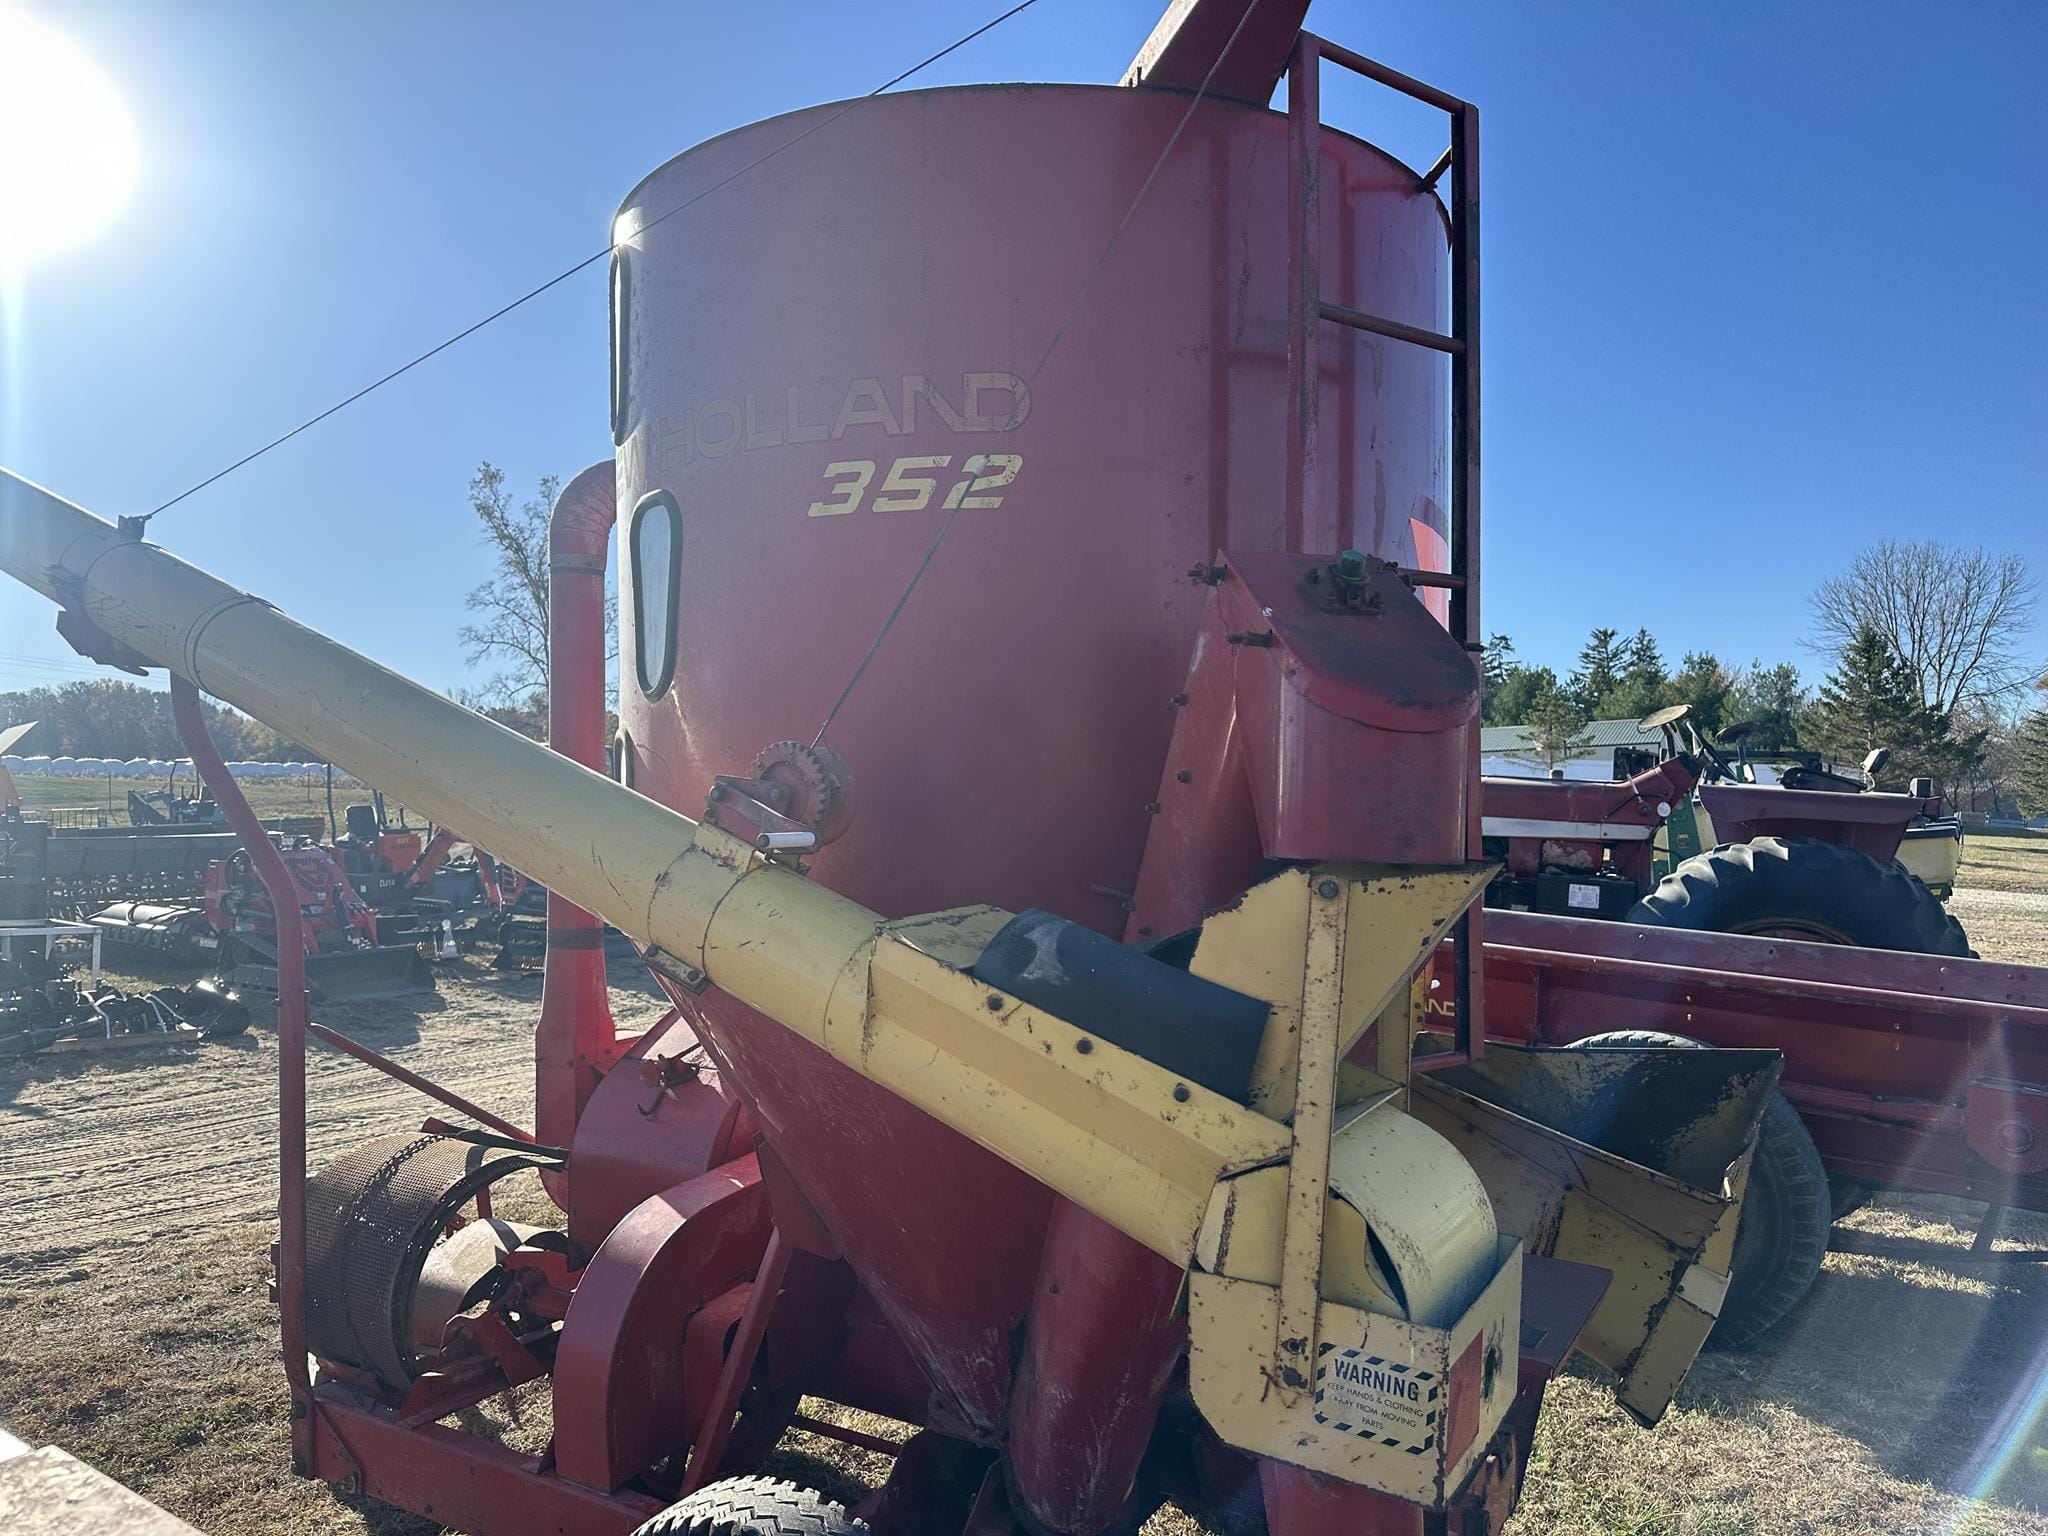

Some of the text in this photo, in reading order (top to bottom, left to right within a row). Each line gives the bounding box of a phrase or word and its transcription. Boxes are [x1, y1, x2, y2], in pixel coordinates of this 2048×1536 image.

[659, 372, 1031, 473] HOLLAND
[807, 453, 1024, 517] 352
[1334, 1358, 1419, 1402] WARNING
[1346, 1387, 1375, 1402] HANDS
[1384, 1399, 1424, 1418] CLOTHING
[1356, 1402, 1379, 1416] FROM
[1381, 1411, 1418, 1428] MOVING
[1361, 1416, 1385, 1430] PARTS
